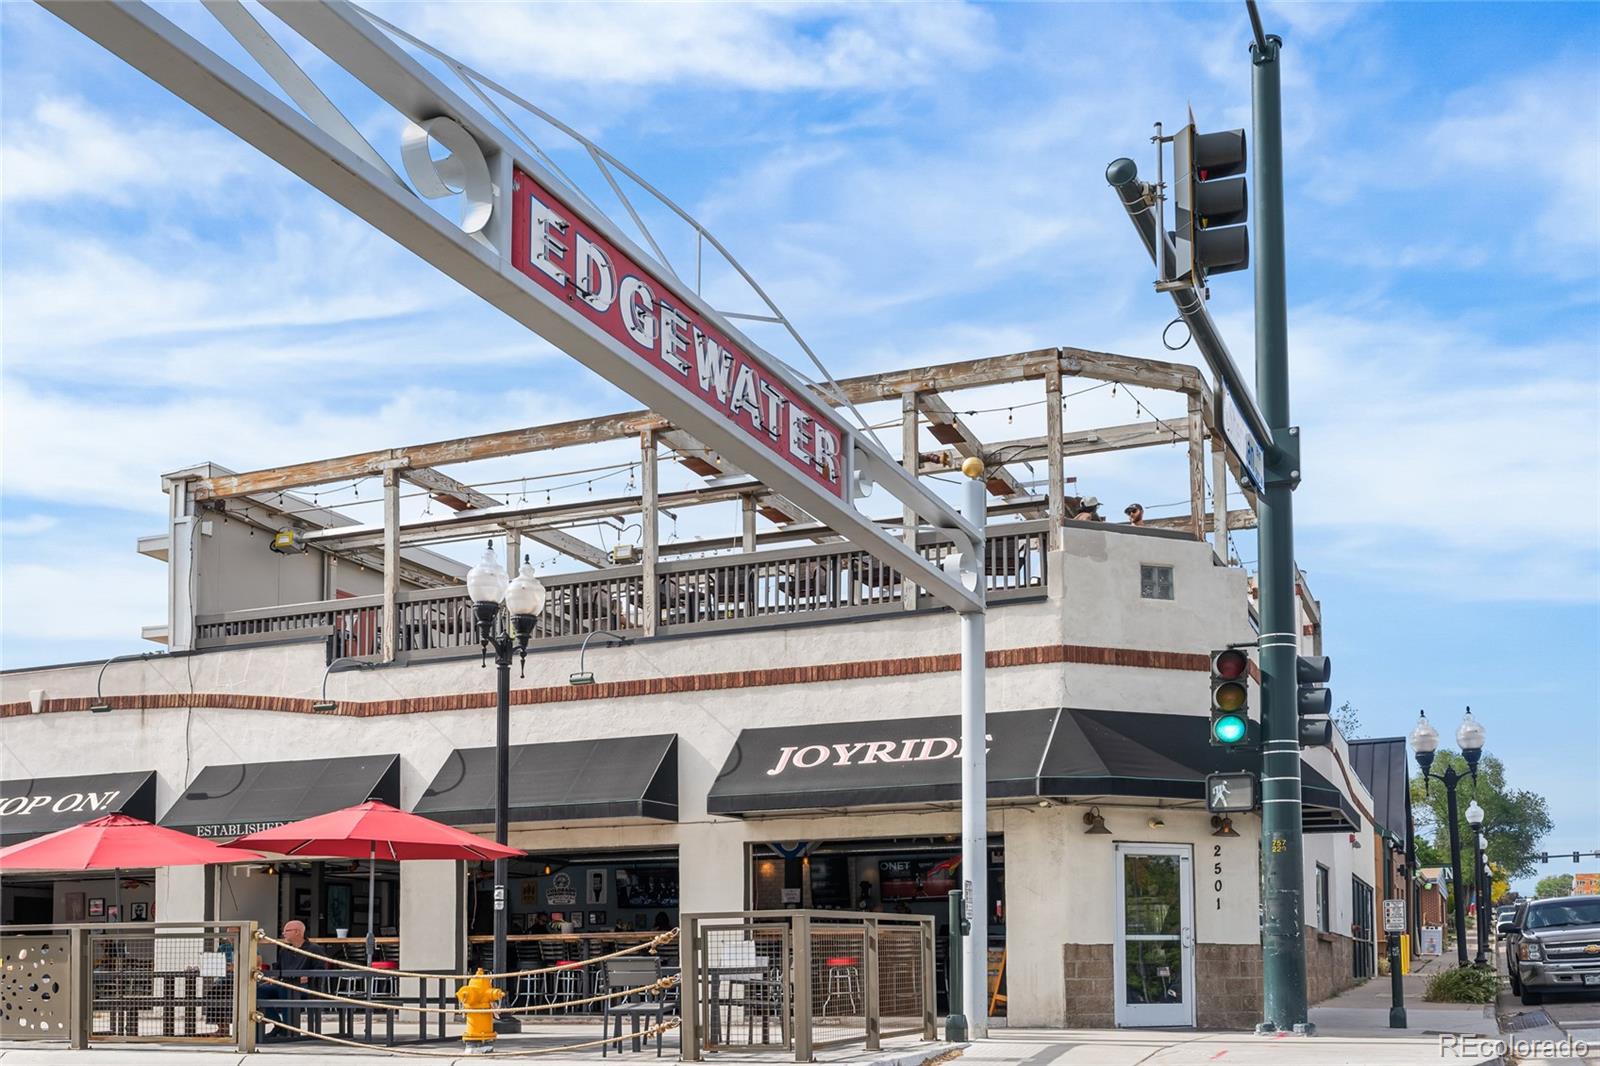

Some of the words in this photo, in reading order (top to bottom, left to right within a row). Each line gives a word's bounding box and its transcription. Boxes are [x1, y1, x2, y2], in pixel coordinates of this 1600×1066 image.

[530, 195, 840, 484] EDGEWATER
[766, 734, 993, 776] JOYRID
[0, 796, 52, 816] OP
[52, 790, 120, 813] ON!
[1213, 844, 1222, 910] 2501
